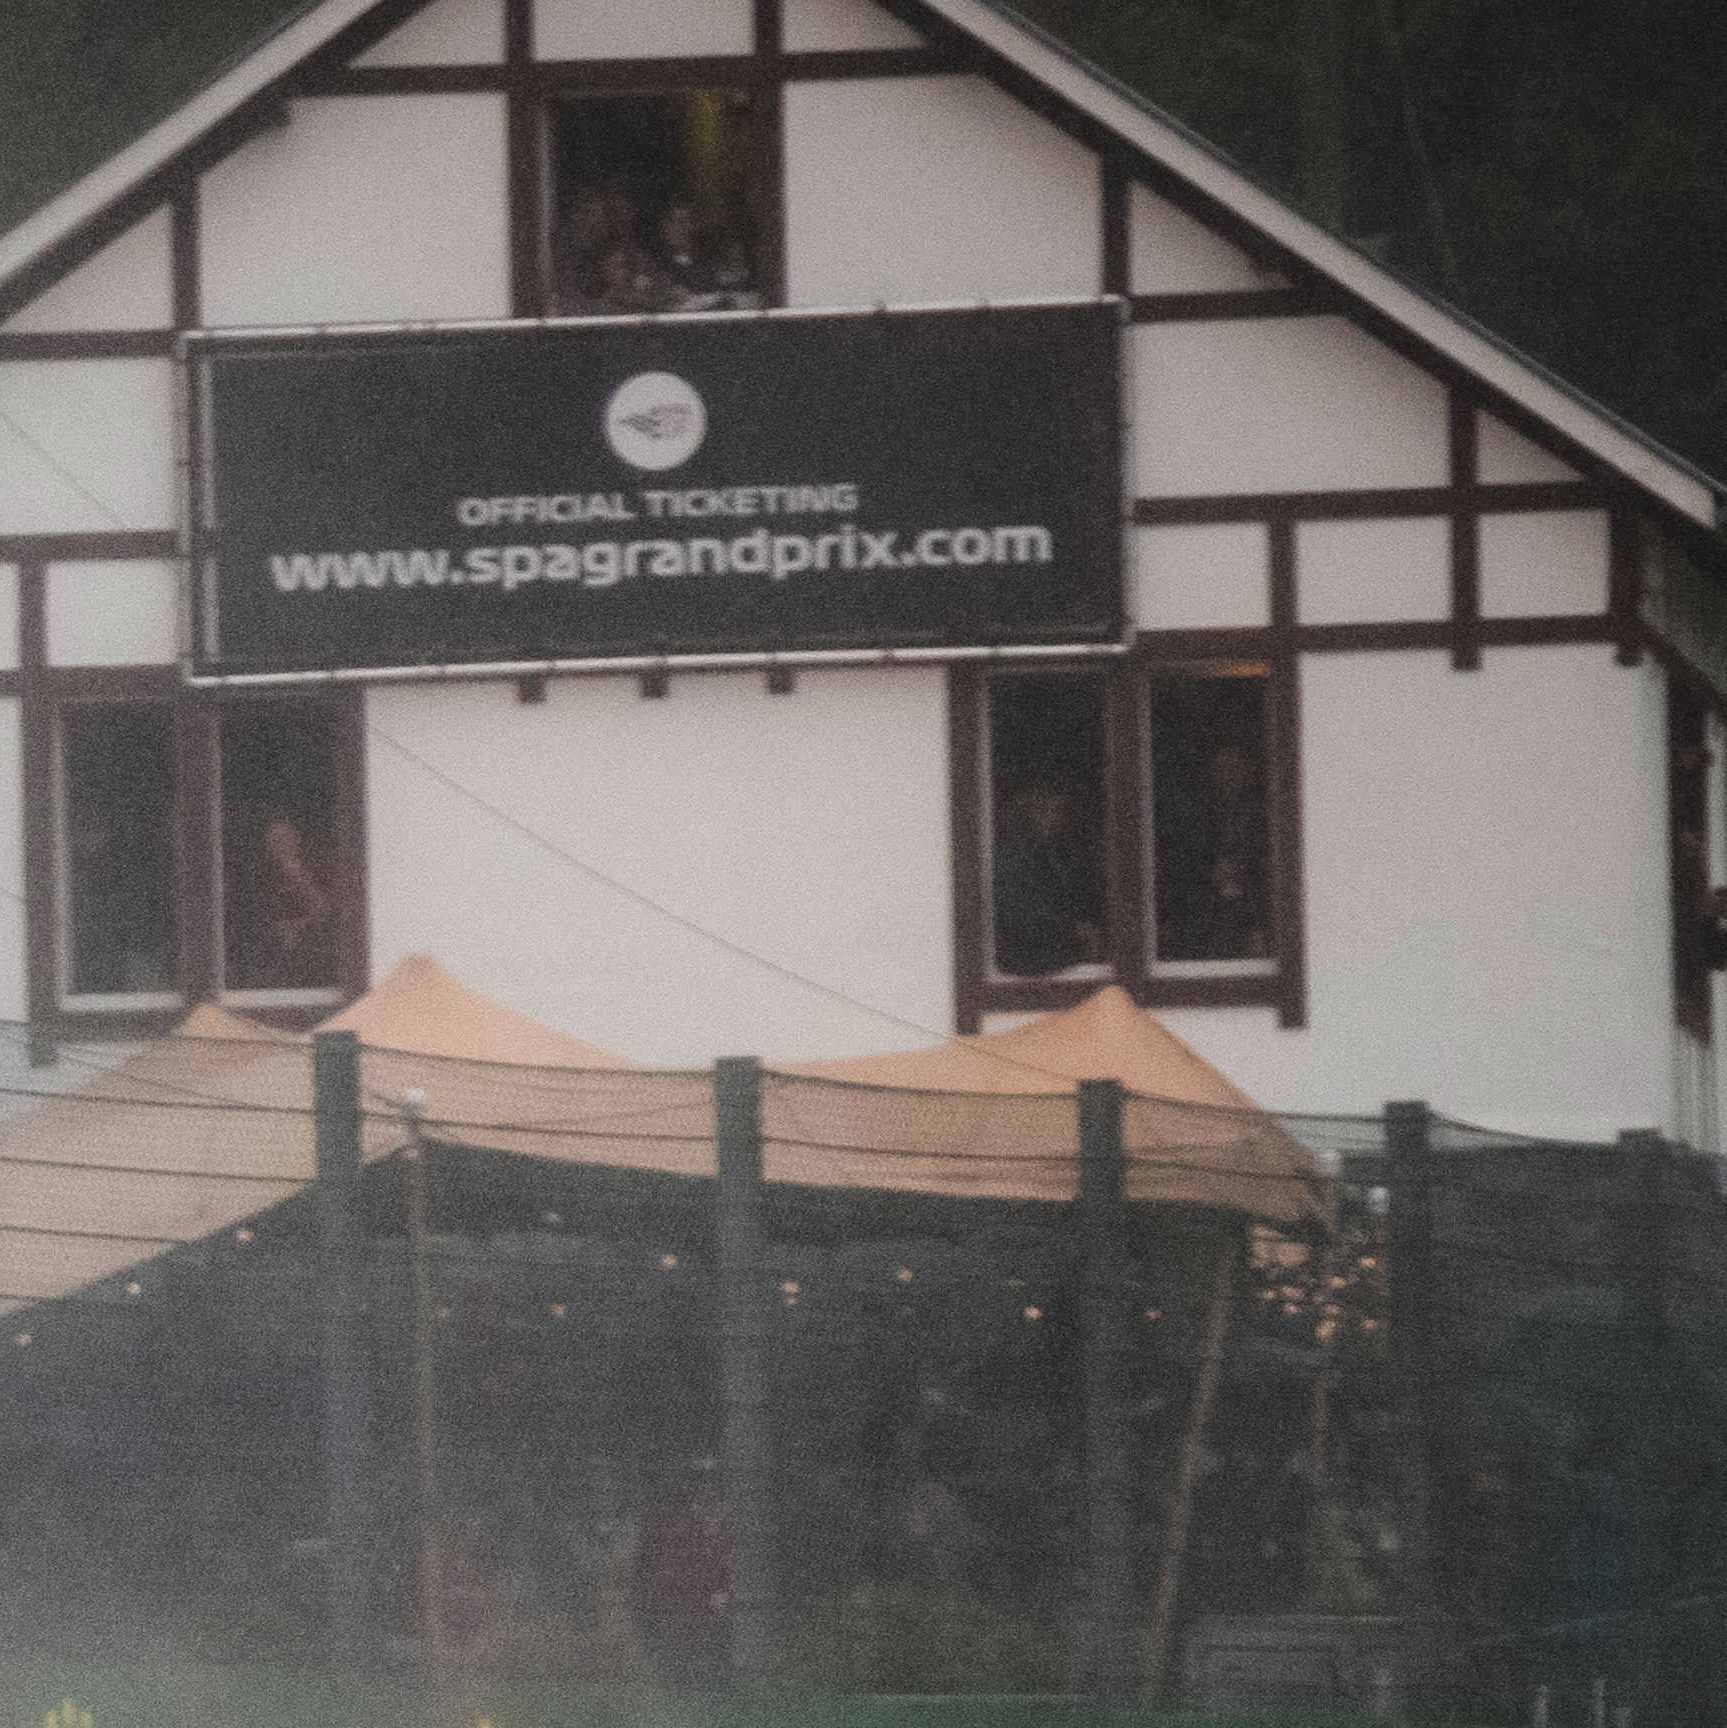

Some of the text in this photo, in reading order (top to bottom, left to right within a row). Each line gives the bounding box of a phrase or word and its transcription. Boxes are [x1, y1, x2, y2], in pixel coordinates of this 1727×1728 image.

[456, 484, 859, 527] OFFICIAL TICKETING
[269, 524, 1052, 592] www.spagrandprix.com
